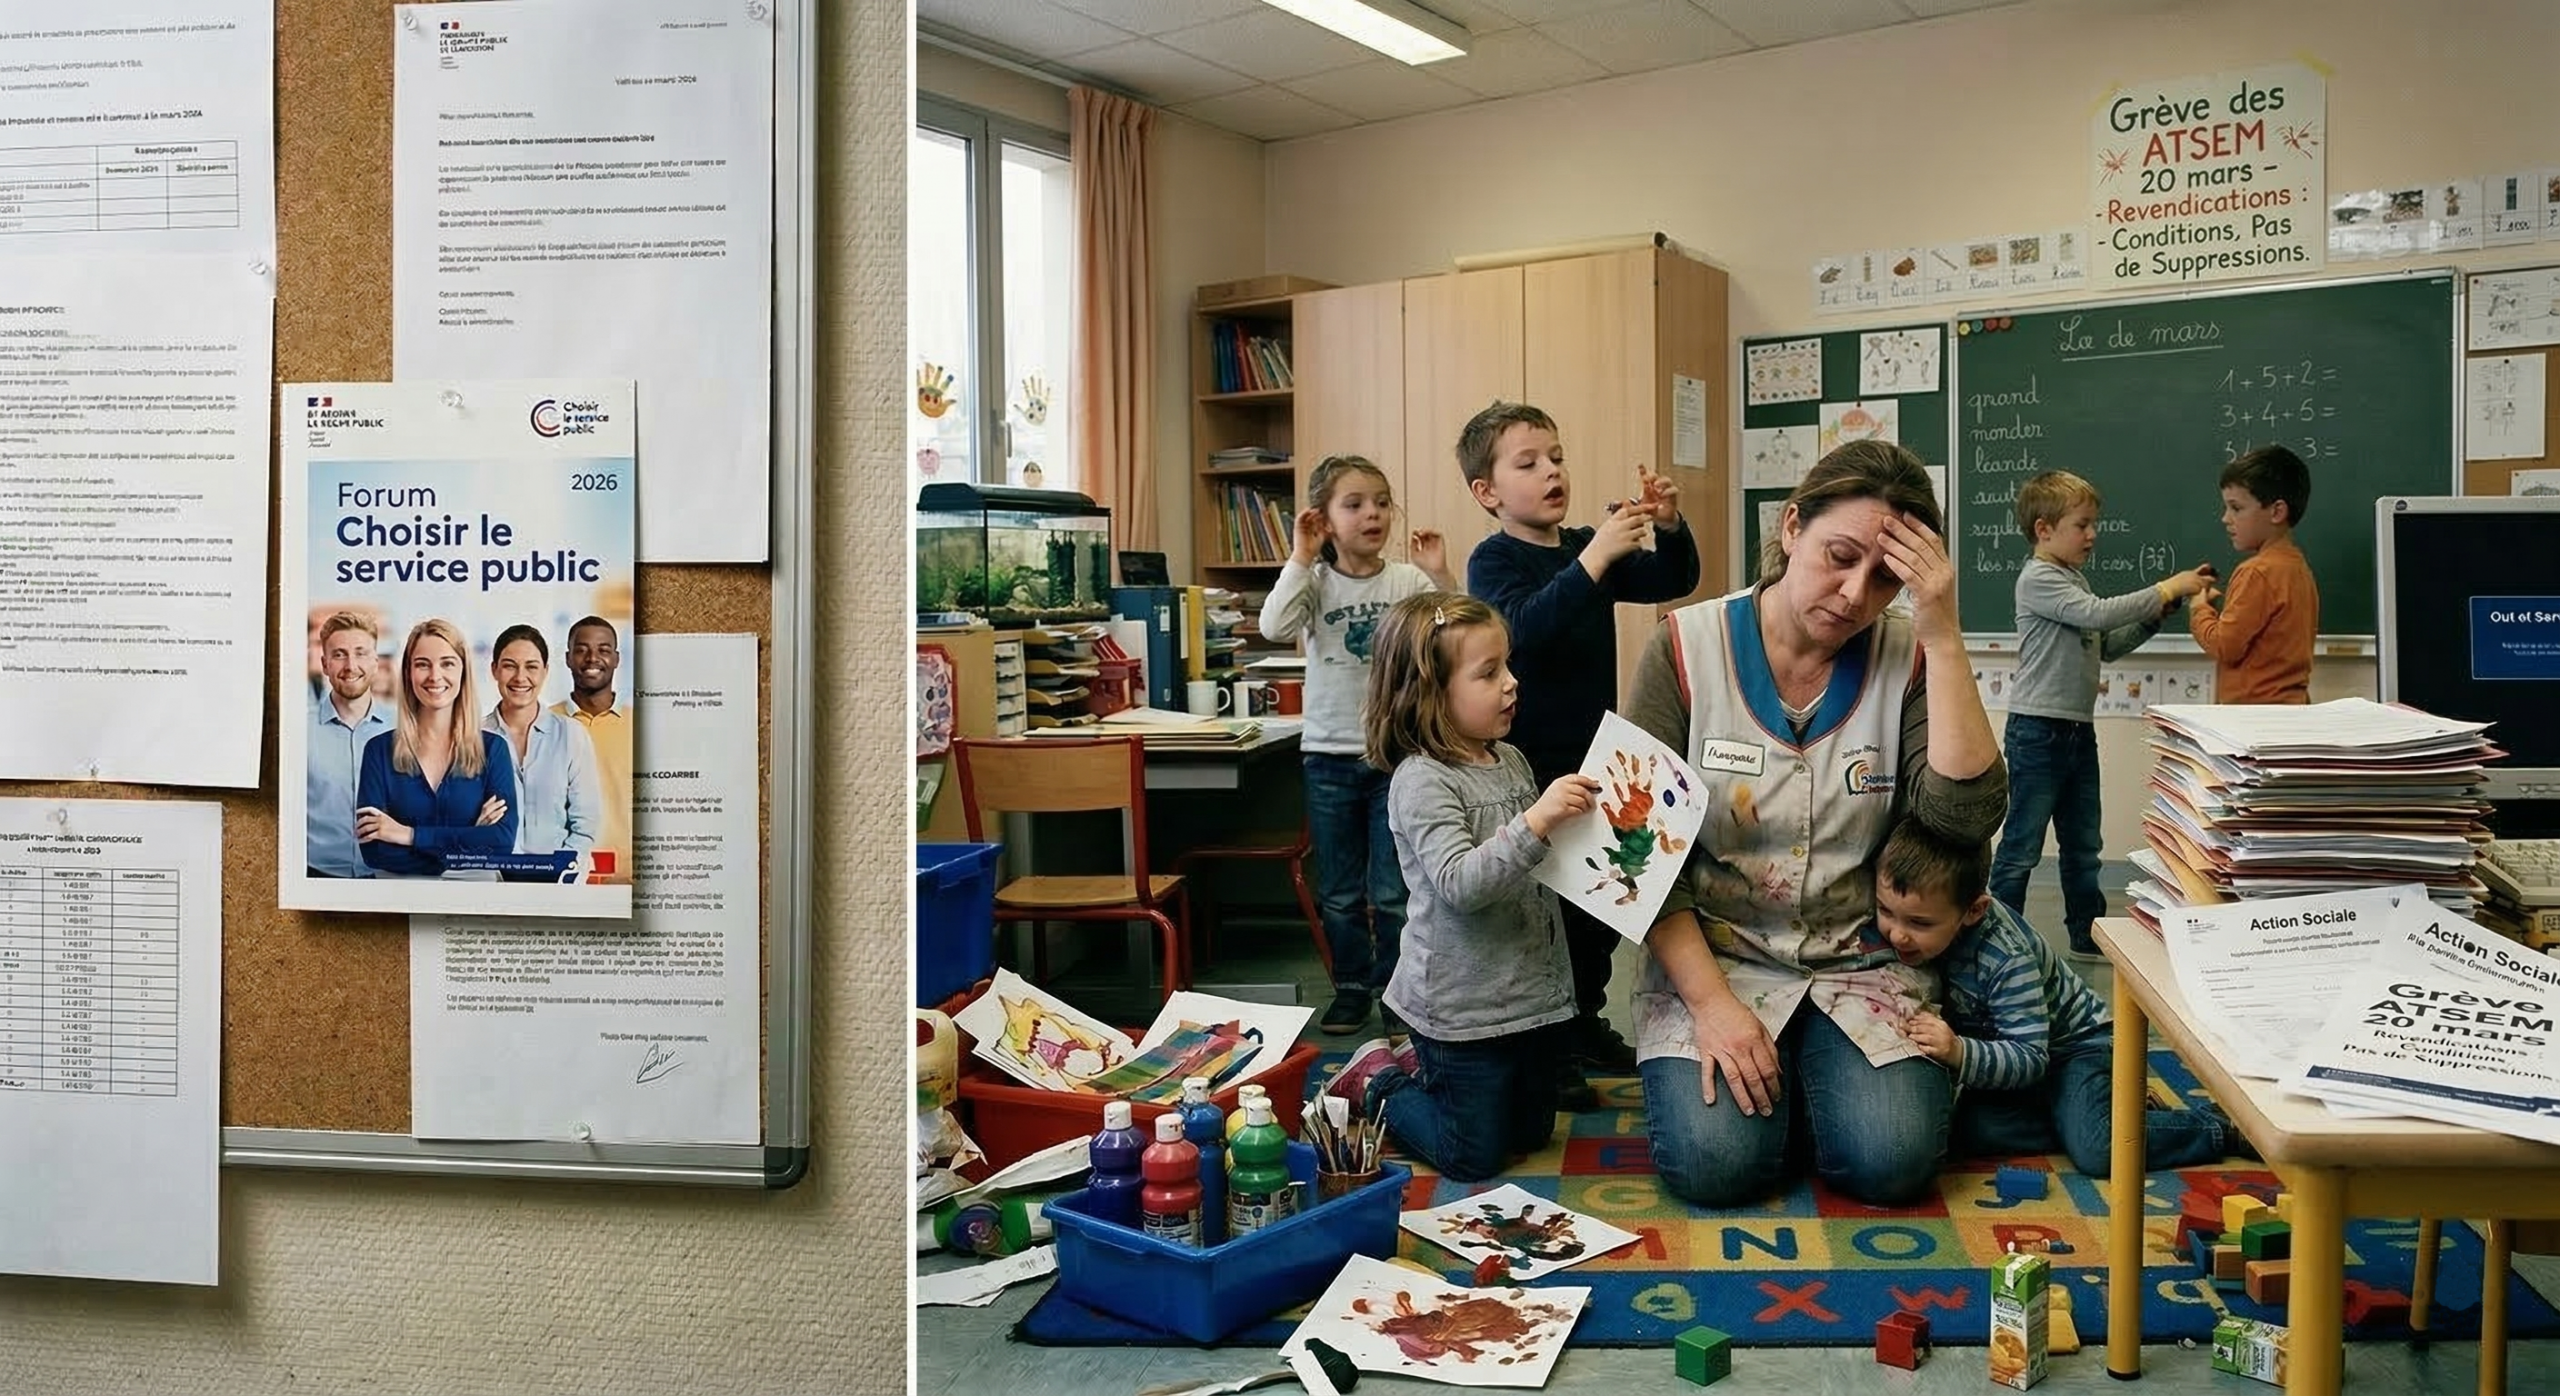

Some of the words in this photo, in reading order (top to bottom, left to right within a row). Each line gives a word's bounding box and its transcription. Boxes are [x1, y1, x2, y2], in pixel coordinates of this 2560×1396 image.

[2110, 94, 2210, 132] Grève
[2229, 81, 2285, 115] des
[2142, 118, 2265, 167] ATSEM
[2140, 168, 2176, 194] 20
[2187, 163, 2253, 188] mars
[2108, 188, 2292, 224] Revendications
[2112, 222, 2241, 251] Conditions,
[2252, 214, 2292, 238] Pas
[2115, 256, 2141, 278] de
[2152, 244, 2310, 280] Suppressions.
[2109, 320, 2136, 348] de
[2150, 321, 2219, 345] mars
[338, 482, 436, 508] Forum
[571, 473, 618, 491] 2026
[336, 514, 469, 547] Choisir
[481, 514, 513, 547] le
[336, 550, 469, 583] service
[482, 550, 600, 592] public
[2250, 915, 2299, 931] Action
[2302, 909, 2357, 926] Sociale
[2424, 922, 2488, 959] Action
[2388, 983, 2544, 1013] Grève
[2362, 1013, 2415, 1028] 20
[2431, 1023, 2546, 1046] mars
[2368, 1000, 2554, 1032] ATSEM
[2343, 1044, 2377, 1055] Pas
[2384, 1050, 2407, 1060] de
[2373, 1030, 2528, 1057] Revendications
[1721, 1226, 1799, 1260] N
[1851, 1226, 1937, 1260] O
